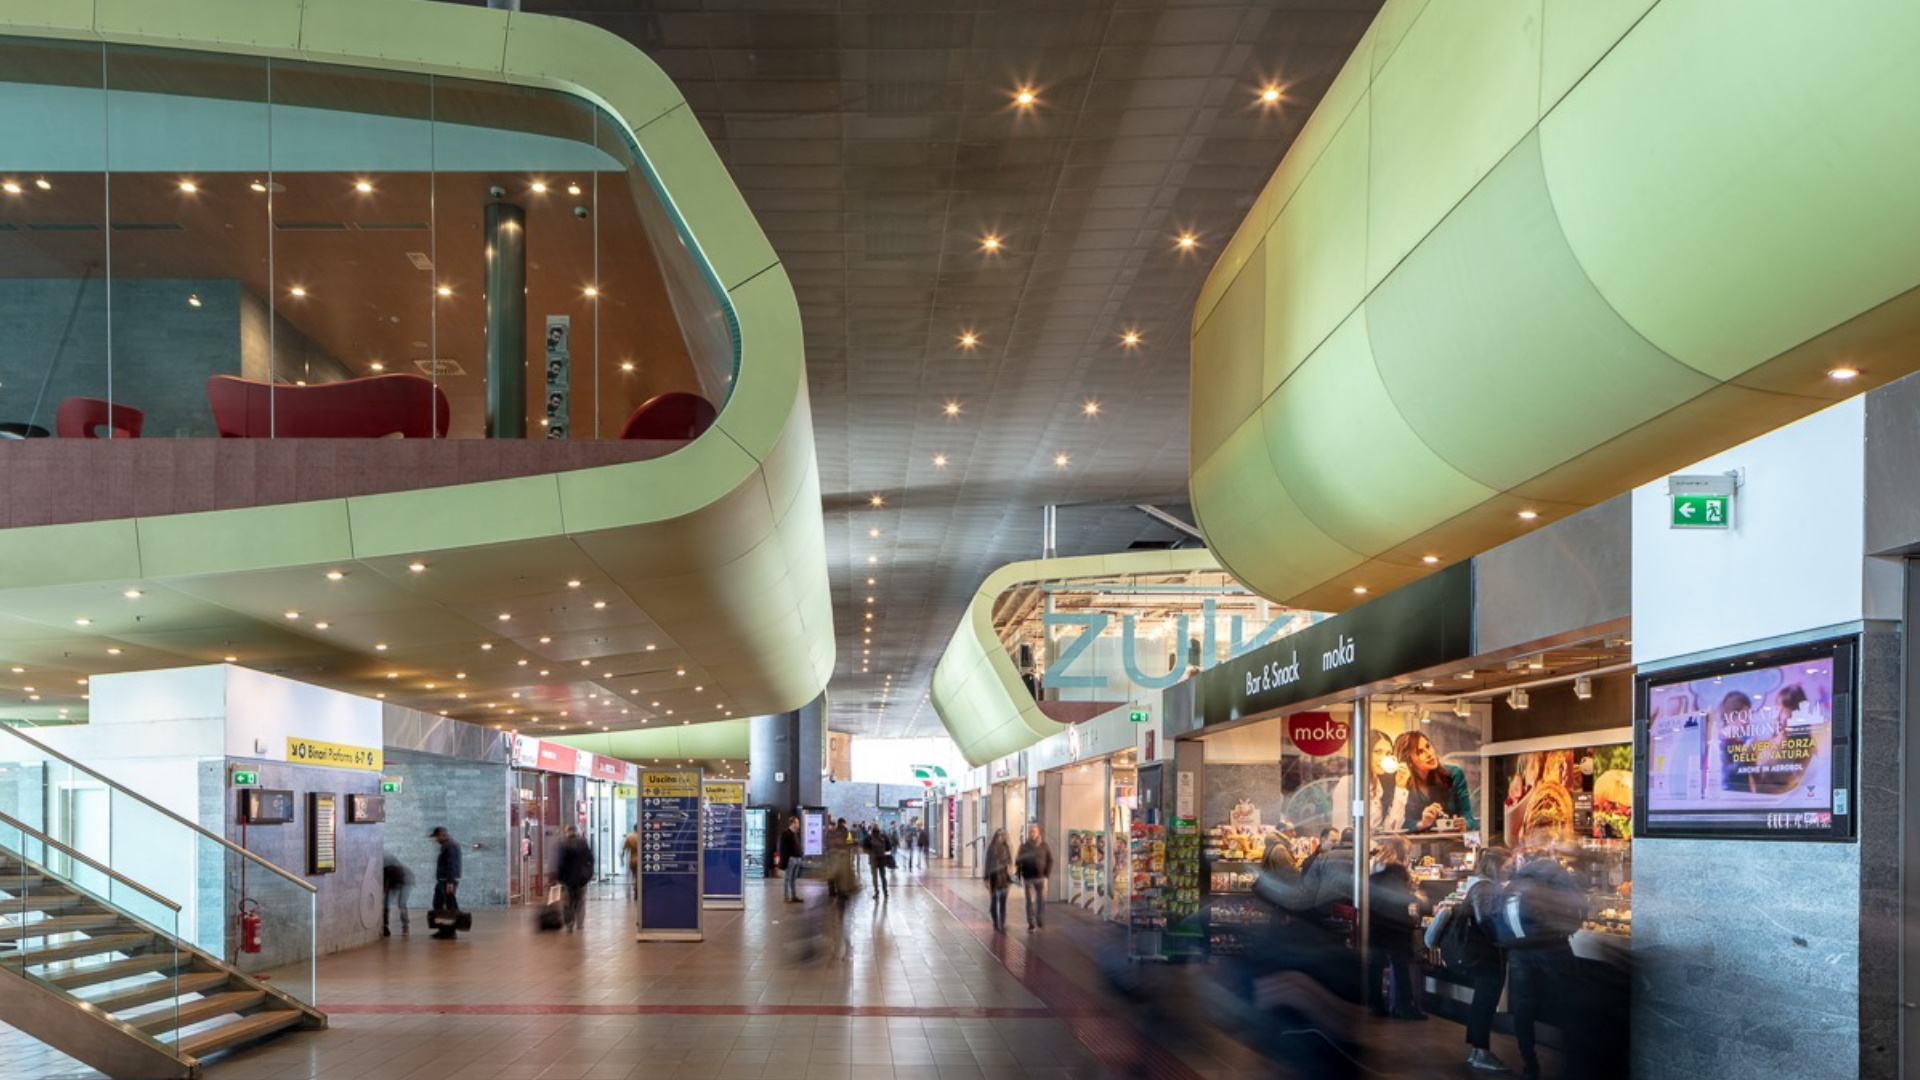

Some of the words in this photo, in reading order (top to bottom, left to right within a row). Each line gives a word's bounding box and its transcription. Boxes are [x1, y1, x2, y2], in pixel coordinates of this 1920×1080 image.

[1245, 671, 1261, 696] Bar
[1262, 664, 1272, 691] &
[1271, 650, 1300, 688] Snack
[1727, 744, 1748, 754] UNA
[1751, 741, 1777, 751] VERA
[1781, 738, 1816, 749] FORZA
[1733, 752, 1763, 763] DELLA
[1768, 748, 1810, 760] NATURA
[649, 775, 677, 783] Uscita
